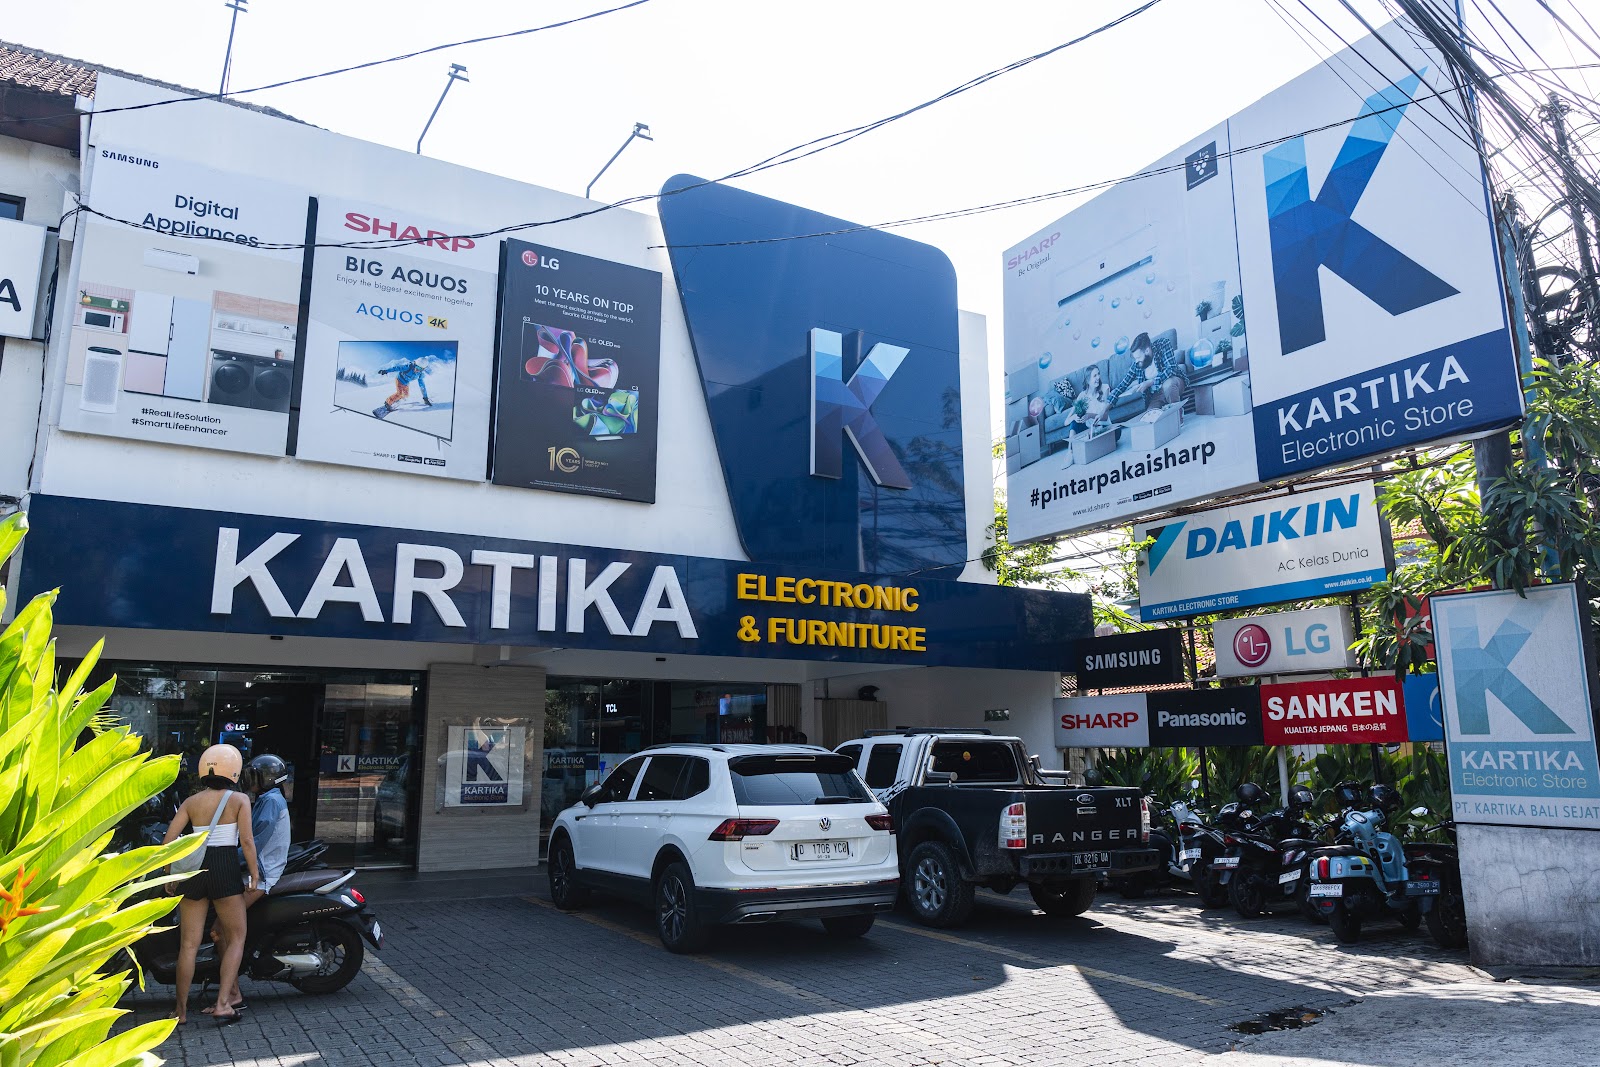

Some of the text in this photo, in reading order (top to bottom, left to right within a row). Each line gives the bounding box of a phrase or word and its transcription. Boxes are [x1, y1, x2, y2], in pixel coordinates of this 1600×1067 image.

[102, 150, 159, 168] SAMSUNG
[175, 194, 238, 220] Digital
[143, 213, 259, 247] Appliances
[344, 212, 476, 252] SHARP
[1008, 232, 1061, 270] SHARP
[540, 256, 560, 270] LG
[346, 256, 468, 294] BIG AQUOS
[336, 274, 474, 307] Enjoy the biggest excitement together
[536, 284, 634, 314] 10 YEARS ON TOP
[356, 303, 448, 328] AQUOS 4K
[569, 306, 586, 314] exciting
[587, 309, 603, 317] arrivals
[1278, 355, 1470, 436] KARTIKA
[132, 418, 228, 435] #SmartLifeEnhancer
[142, 408, 221, 424] #RealLifeSolution
[1282, 398, 1474, 464] Electronic Store
[1030, 441, 1216, 510] #pintarpakaisharp
[1072, 502, 1110, 516] www.id.sharp
[1186, 494, 1360, 560] DAIKIN
[1278, 548, 1368, 572] AC Kelas Dunia
[210, 526, 698, 639] KARTIKA
[737, 573, 919, 612] ELECTRONIC
[1324, 576, 1372, 588] www.daikin.co.id
[1152, 595, 1239, 616] KARTIKA ELECTRONIC STORE
[737, 616, 926, 652] & FURNITURE
[1285, 623, 1331, 656] LG
[1085, 648, 1161, 671] SAMSUNG
[606, 704, 617, 713] TCL
[1268, 690, 1398, 720] SANKEN
[1061, 712, 1139, 730] SHARP
[1158, 708, 1247, 727] Panasonic
[1352, 723, 1387, 732] 日本の品質
[1284, 724, 1348, 734] KUALITAS JEPANG
[1461, 750, 1584, 770] KARTIKA
[1463, 772, 1587, 788] Electronic Store
[1115, 797, 1131, 807] XLT
[1455, 802, 1471, 814] PT.
[1475, 802, 1526, 816] KARTIKA
[1531, 804, 1558, 818] BALI
[1032, 829, 1136, 844] RANGER
[799, 844, 804, 854] D
[812, 844, 830, 854] 1706
[1074, 855, 1082, 864] DK
